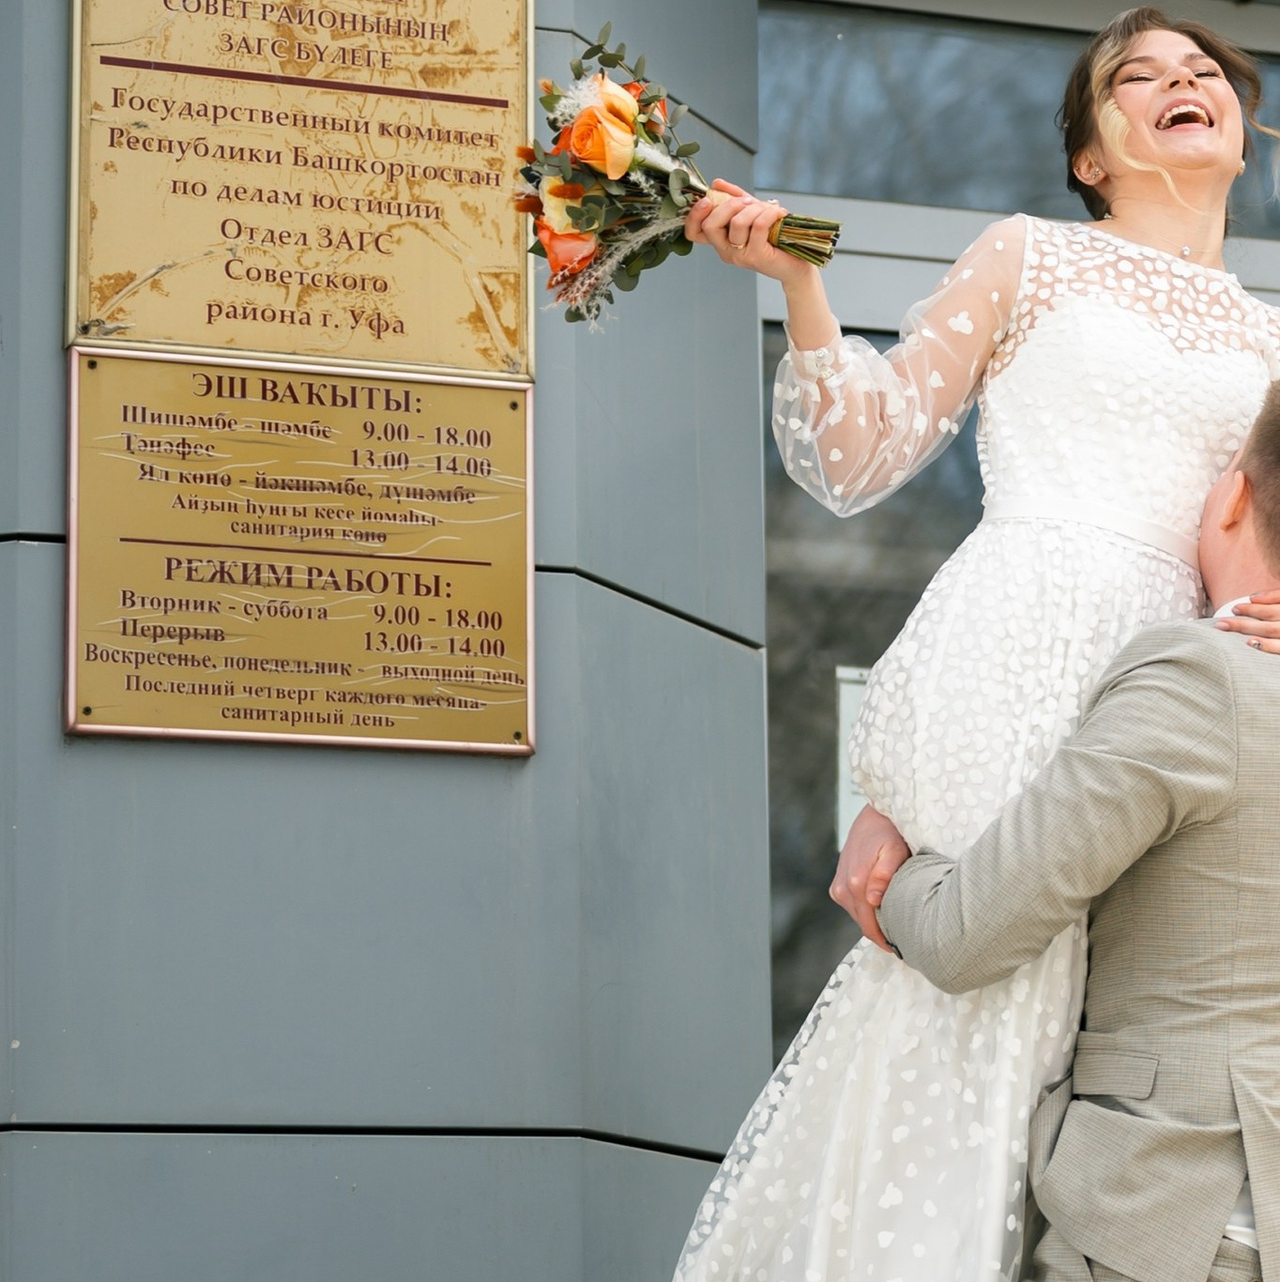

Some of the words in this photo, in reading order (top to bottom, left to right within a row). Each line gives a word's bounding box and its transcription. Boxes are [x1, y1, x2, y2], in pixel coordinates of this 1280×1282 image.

[220, 33, 289, 60] ЗАГС
[111, 87, 370, 135] Государственный
[379, 123, 499, 149] комитет
[108, 127, 282, 166] Республики
[292, 147, 501, 187] Башкортостан
[171, 180, 207, 198] по
[217, 185, 302, 208] делам
[312, 194, 441, 220] юстиции
[221, 218, 309, 247] Отдел
[318, 228, 393, 255] ЗАГС
[224, 259, 389, 294] Советского
[206, 301, 312, 327] района
[320, 312, 339, 329] г.
[350, 310, 405, 339] Уфа
[192, 373, 248, 400] ЭШ
[363, 421, 409, 443] 9.00
[433, 427, 491, 449] 18.00
[351, 449, 409, 472] 13.00
[433, 454, 491, 477] 14.00
[230, 518, 334, 543] санитария
[164, 557, 292, 589] РЕЖИМ
[306, 567, 452, 598] РАБОТЫ:
[121, 589, 221, 615] Вторник
[244, 598, 328, 625] суббота
[374, 604, 420, 626] 9.00
[445, 608, 503, 631] 18.00
[121, 618, 225, 645] Перерыв
[364, 630, 422, 653] 13.00
[448, 635, 505, 659] 14.00
[85, 642, 217, 671] Воскресенье,
[224, 654, 352, 678] понедельник
[381, 662, 475, 685] выходной
[126, 674, 234, 698] Последний
[242, 686, 316, 706] четверг
[325, 689, 405, 708] каждого
[221, 706, 344, 727] санитарный
[351, 714, 395, 728] день
